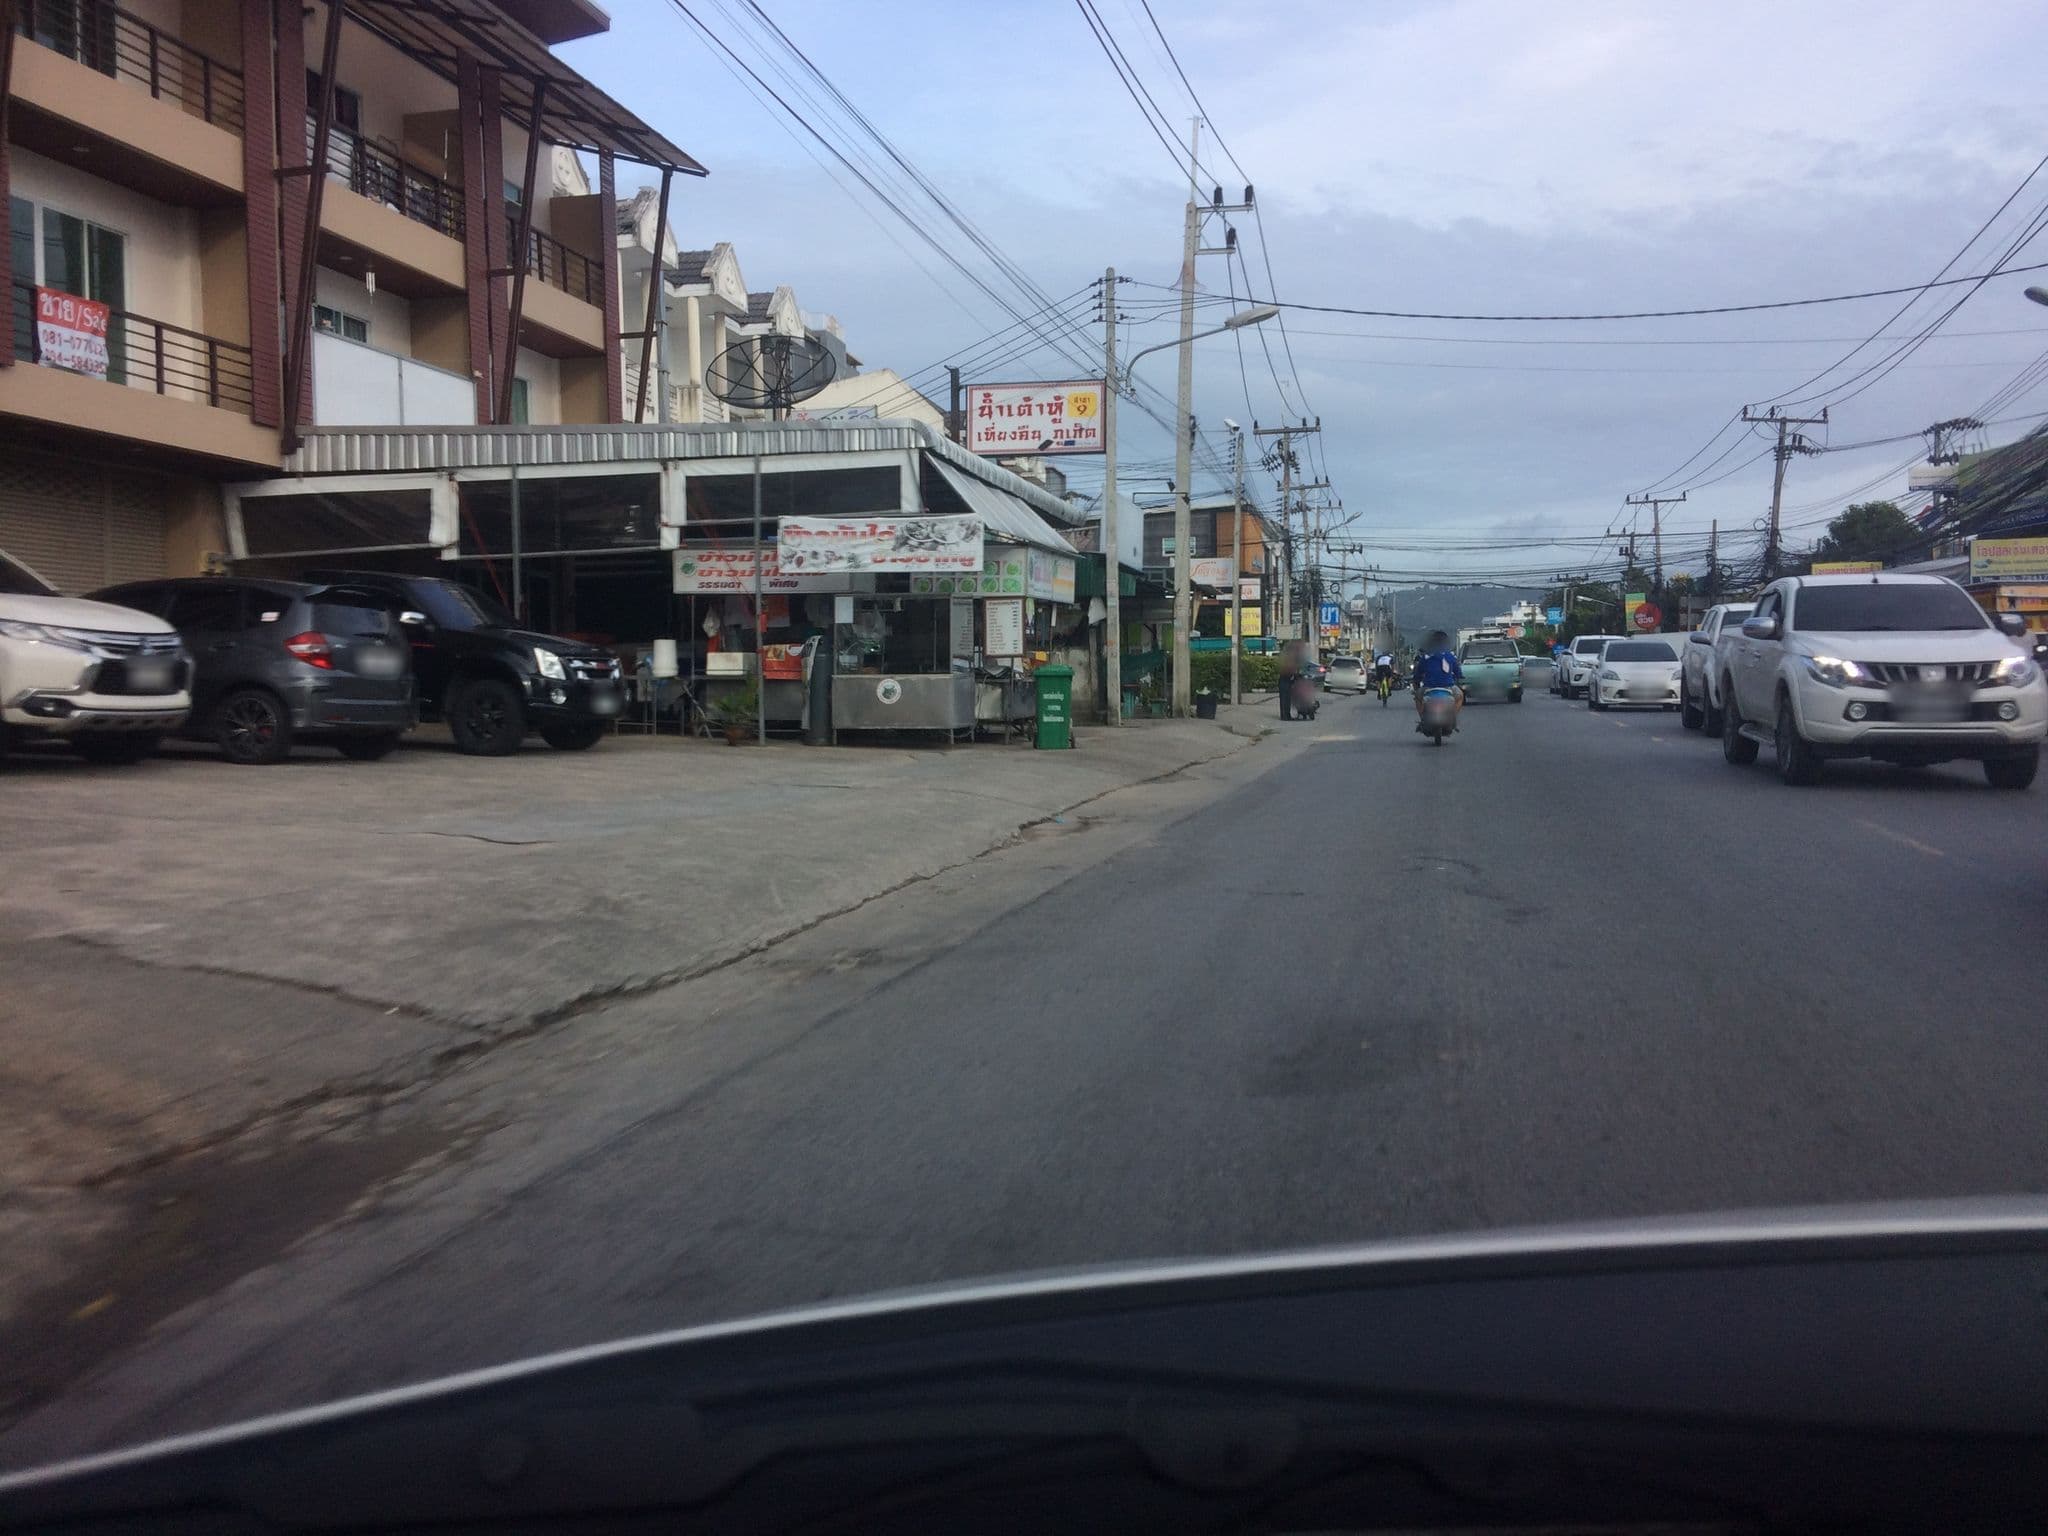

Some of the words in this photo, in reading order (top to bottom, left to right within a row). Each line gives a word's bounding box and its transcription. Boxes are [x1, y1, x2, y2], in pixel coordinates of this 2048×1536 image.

[978, 392, 1065, 424] น้ำเต้าหู้
[1321, 606, 1339, 624] ยา
